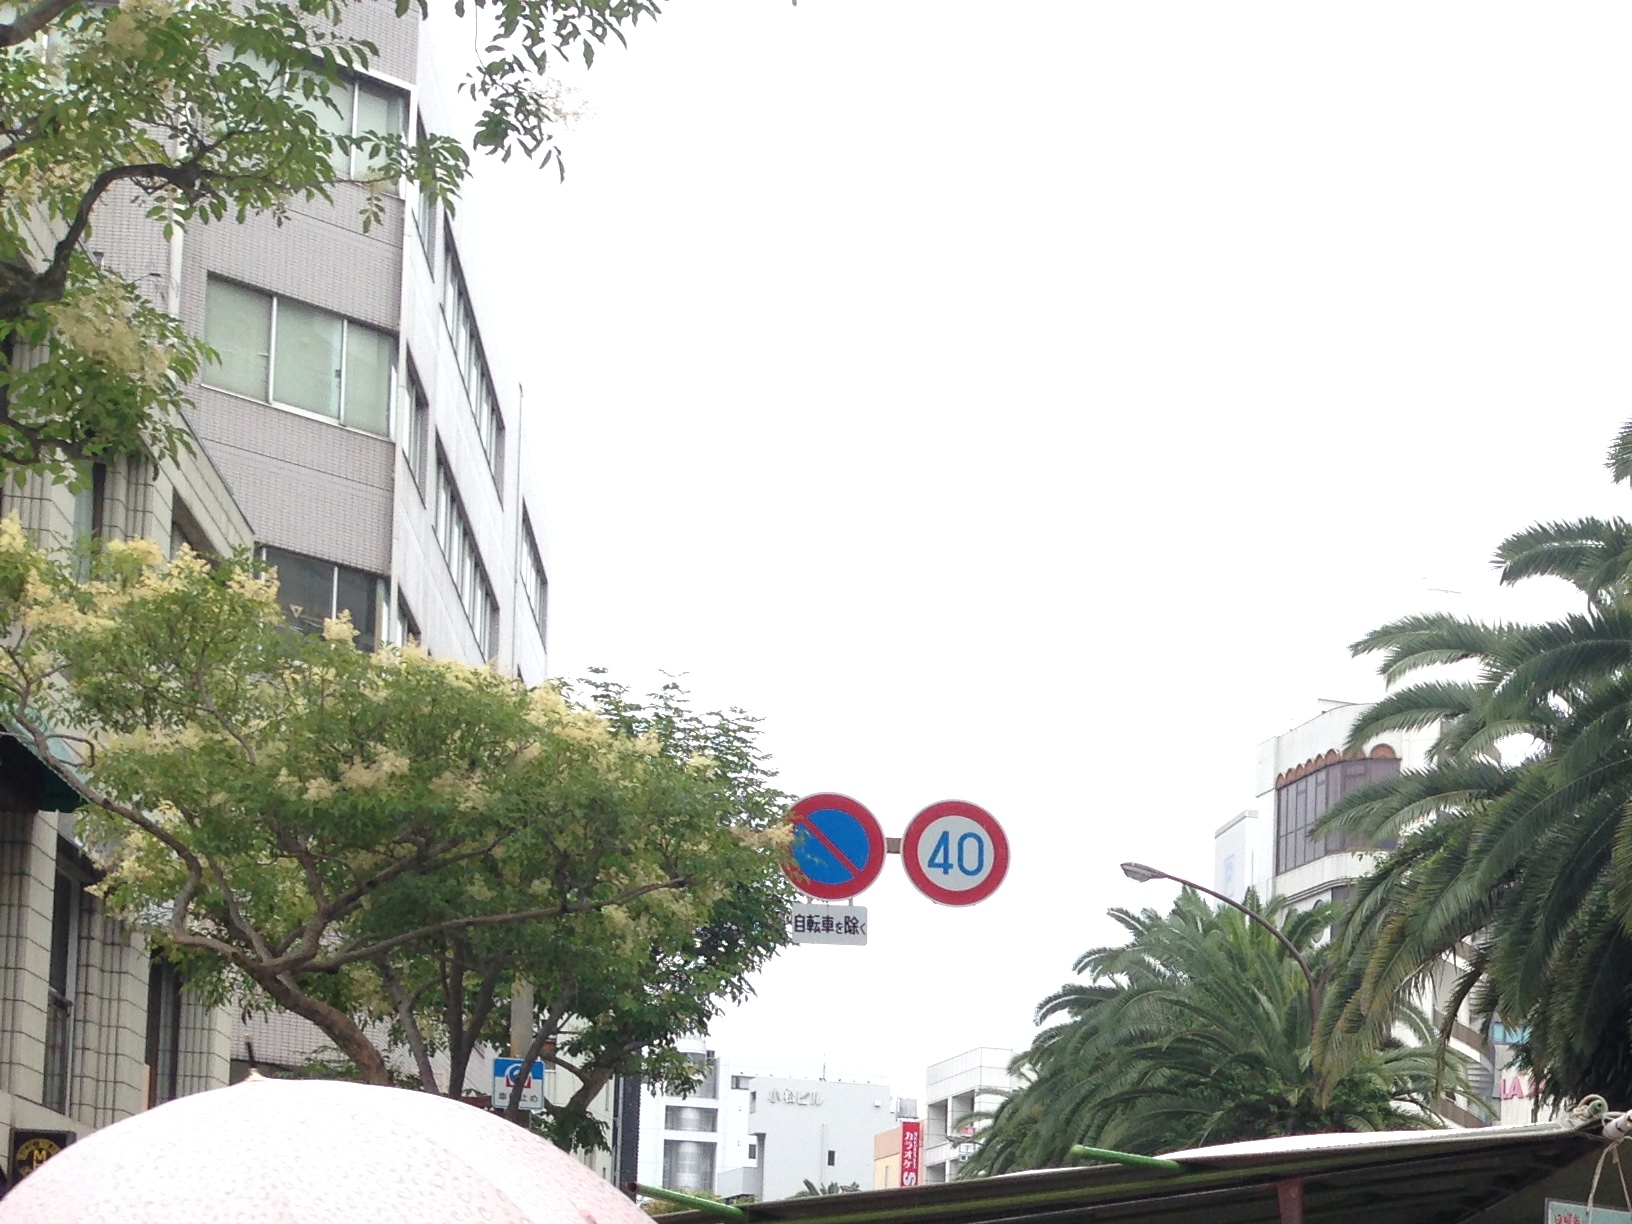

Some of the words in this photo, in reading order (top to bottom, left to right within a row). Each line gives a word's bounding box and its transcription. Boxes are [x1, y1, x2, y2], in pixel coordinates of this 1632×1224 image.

[927, 831, 985, 877] 40
[793, 914, 867, 936] 自転車を除く
[903, 1131, 914, 1169] カラオケ
